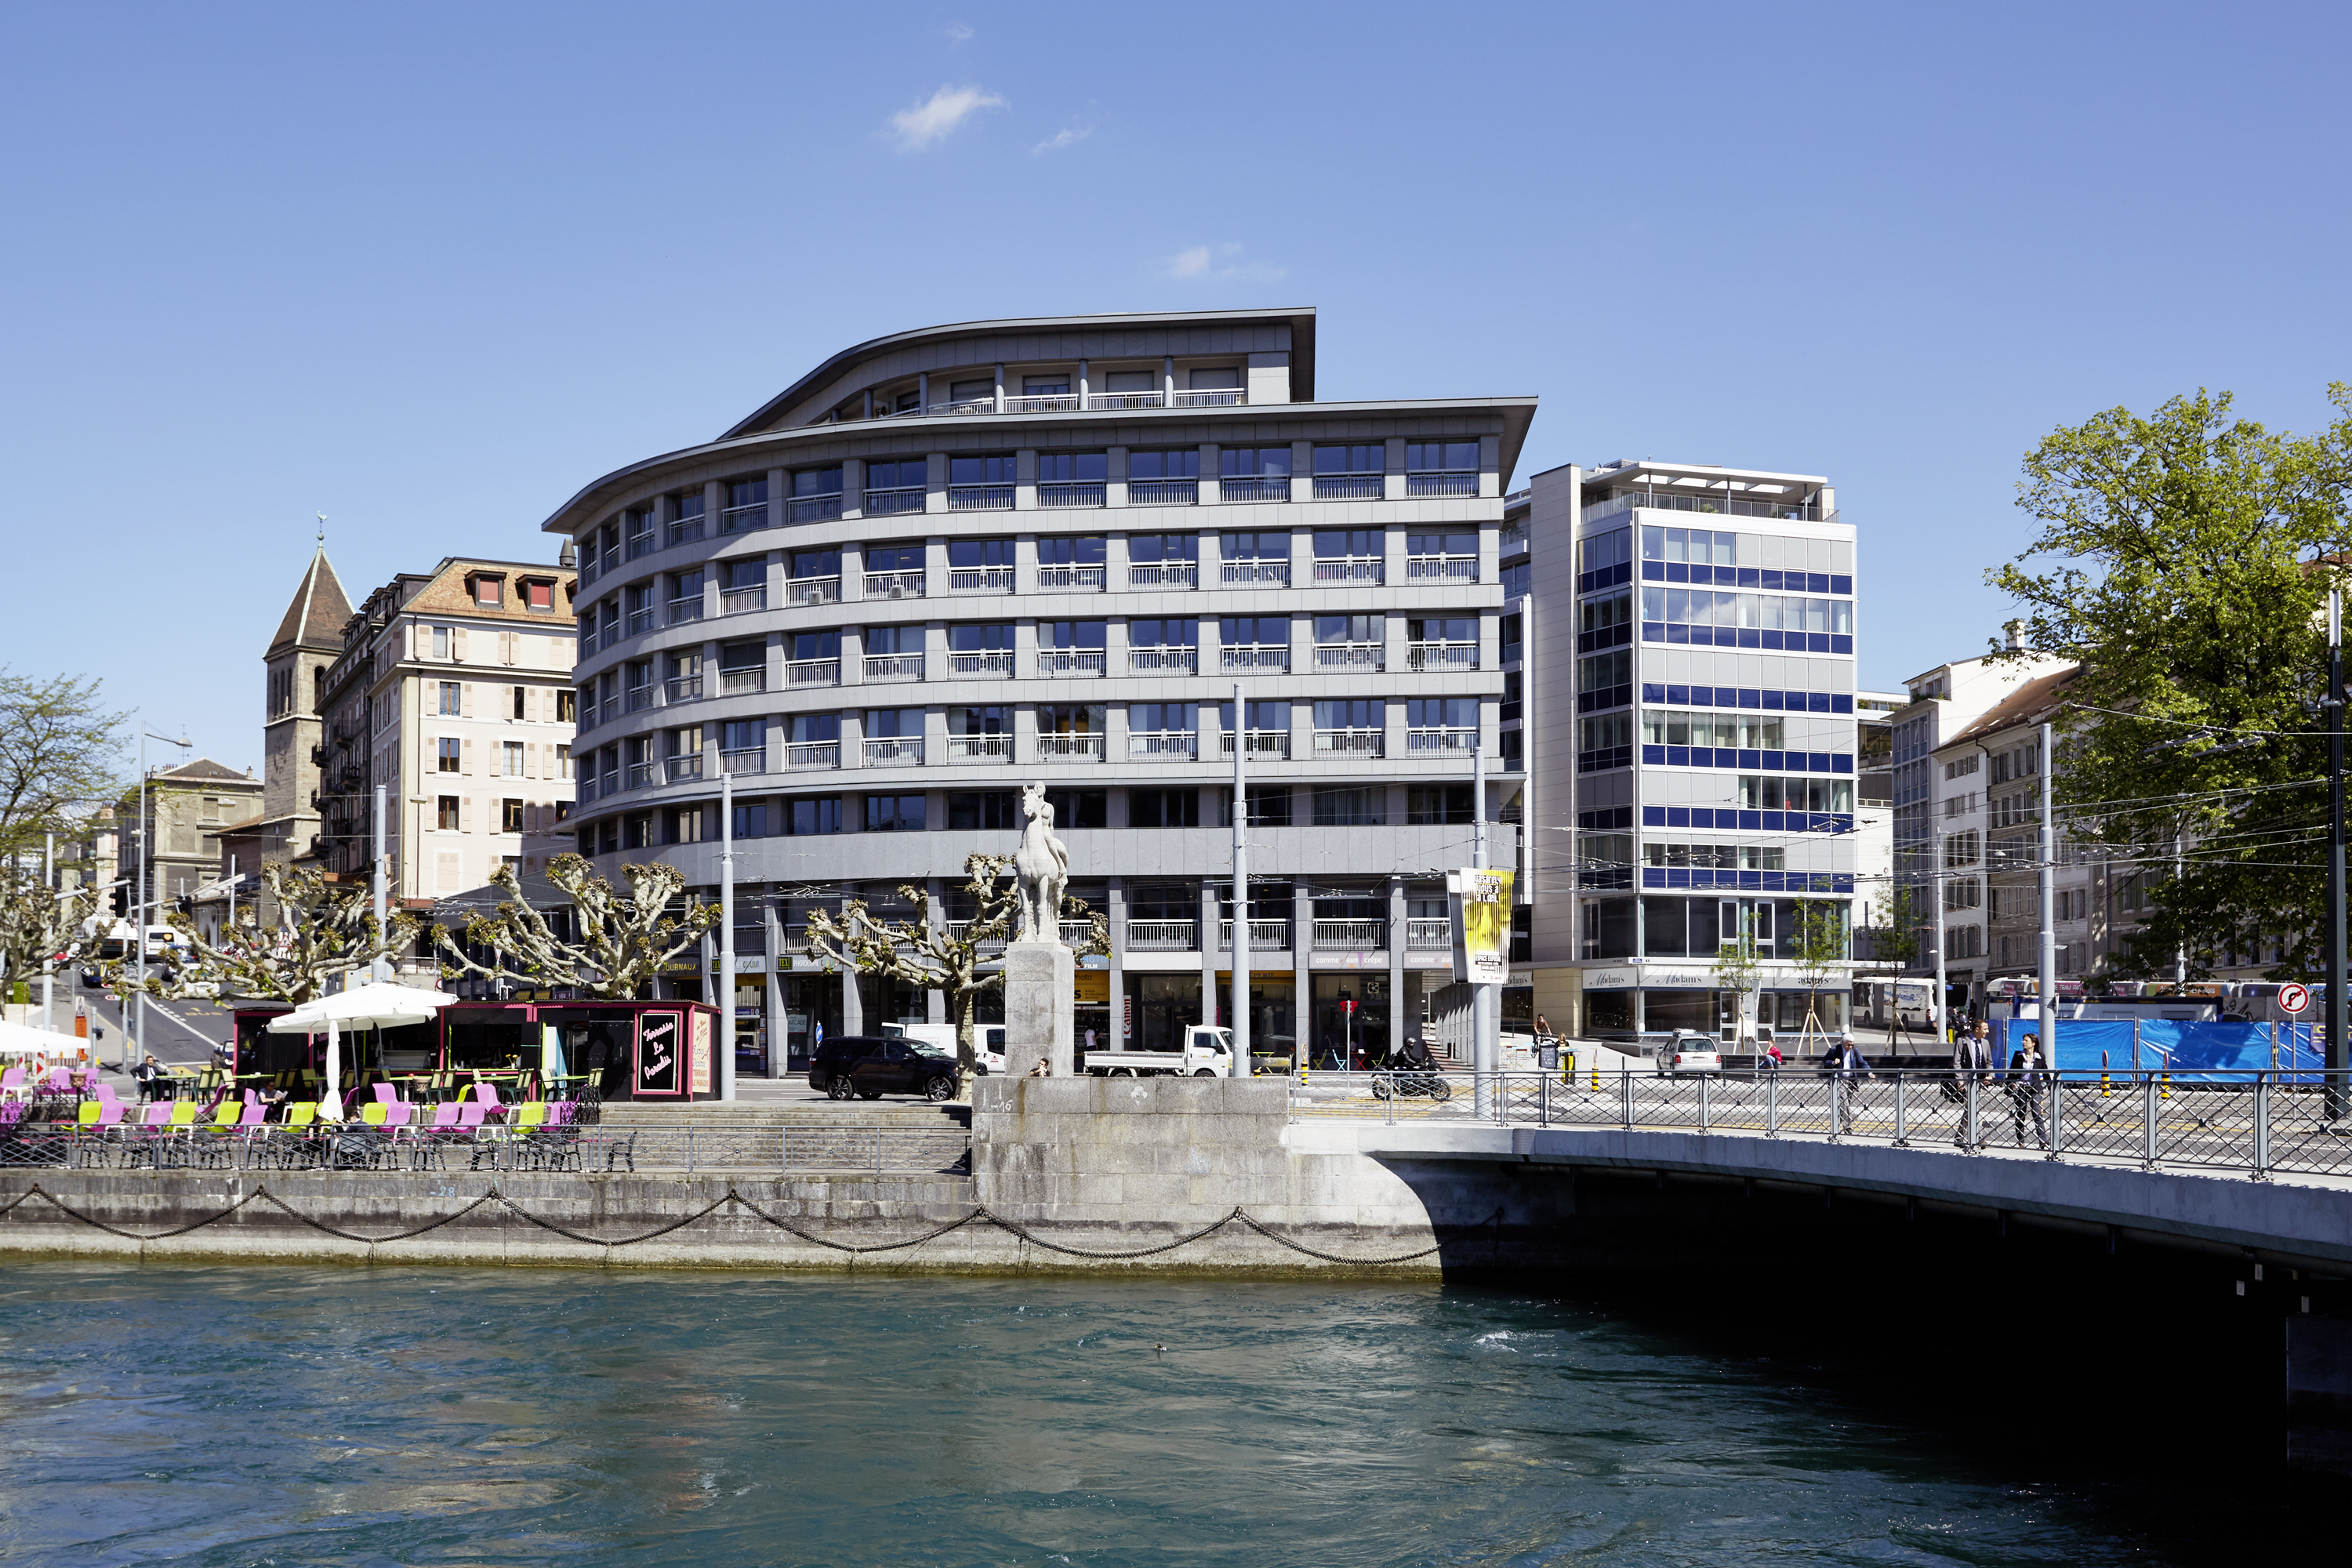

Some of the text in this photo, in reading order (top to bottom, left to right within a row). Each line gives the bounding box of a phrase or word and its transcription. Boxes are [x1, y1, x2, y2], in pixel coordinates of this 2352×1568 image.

[1364, 956, 1382, 966] crêpe
[1589, 972, 1624, 985] Madam's
[1656, 970, 1702, 985] Madam's
[643, 1022, 674, 1042] Terrasse
[644, 1055, 672, 1080] Paradis
